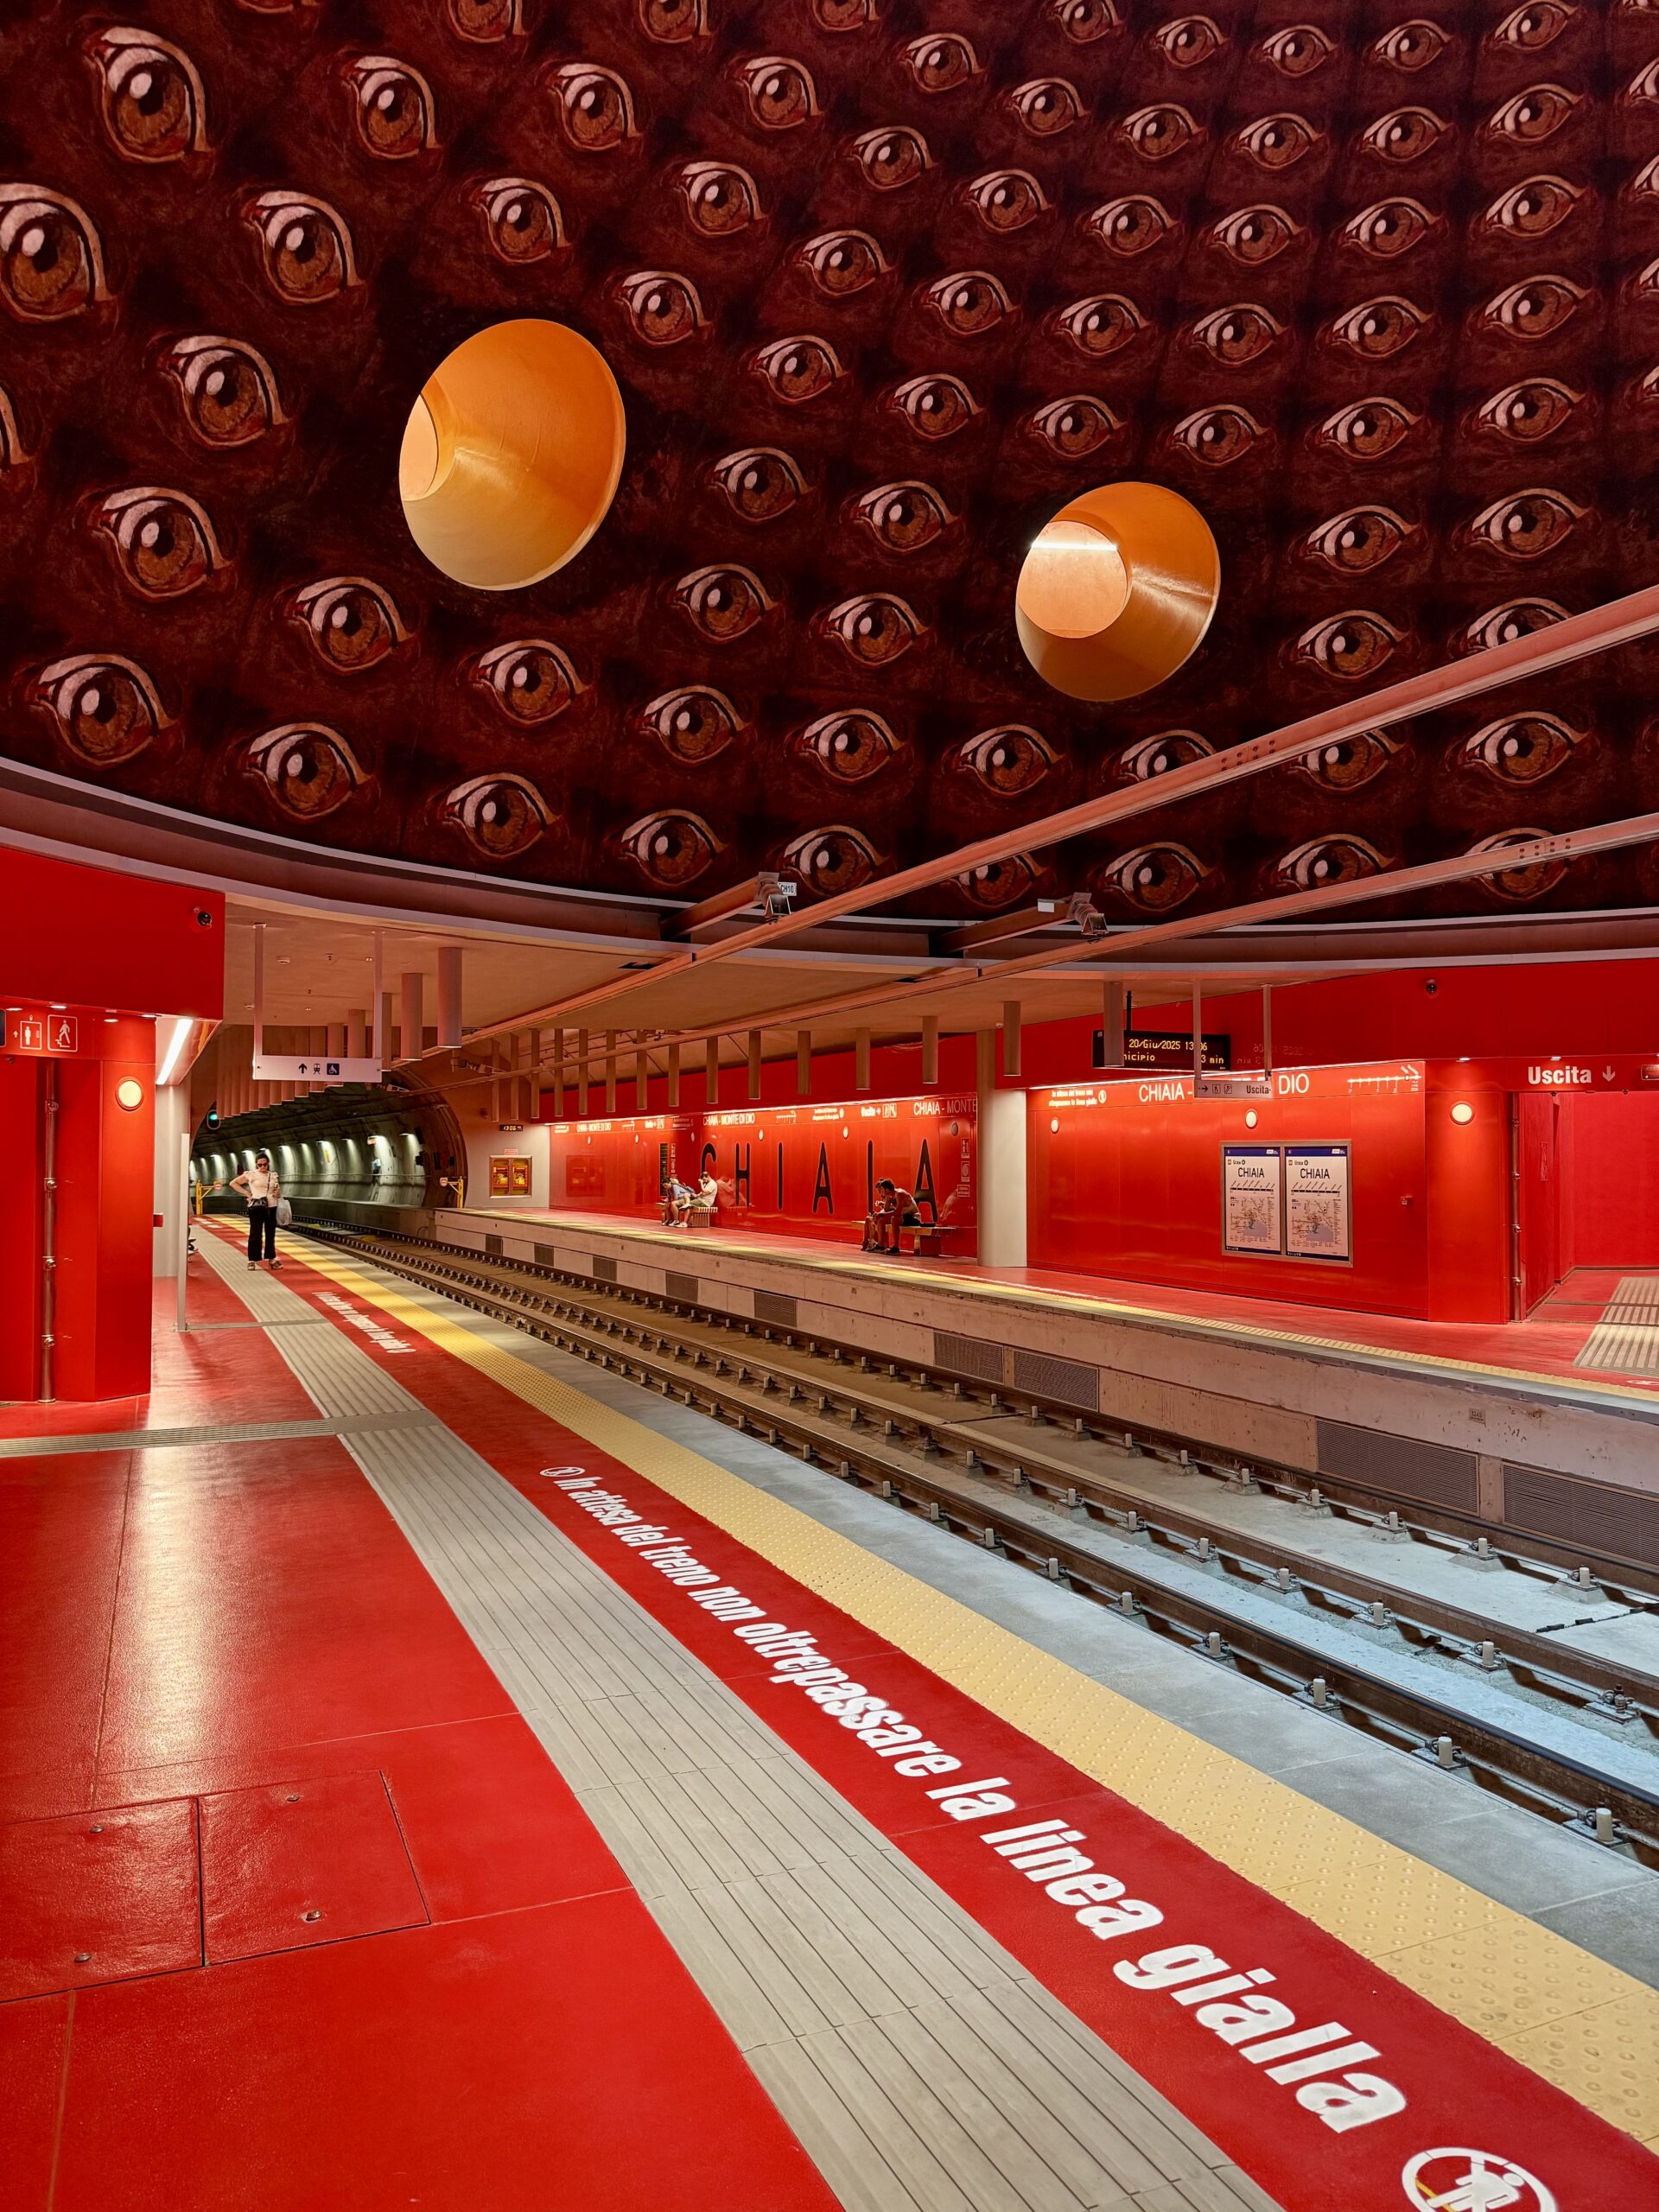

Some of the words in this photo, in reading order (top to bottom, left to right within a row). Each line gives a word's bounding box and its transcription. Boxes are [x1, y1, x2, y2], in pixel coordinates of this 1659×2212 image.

[1128, 1039, 1181, 1050] 20/Giu/2025
[1209, 1054, 1224, 1064] min
[1527, 1065, 1592, 1085] Uscita
[1138, 1082, 1185, 1103] CHIAIA
[1278, 1073, 1310, 1095] DIO
[1245, 1084, 1270, 1095] Uscita
[912, 1101, 941, 1116] CHIAIA
[1237, 1166, 1265, 1179] CHIAIA
[1300, 1168, 1331, 1179] CHIAIA
[553, 1476, 603, 1490] In
[567, 1490, 644, 1526] attesa
[611, 1524, 685, 1547] del
[639, 1545, 721, 1586] treno
[687, 1586, 767, 1622] non
[733, 1623, 963, 1777] oltrepassare
[925, 1777, 1017, 1821] la
[979, 1818, 1165, 1941] linea
[1112, 1944, 1408, 2133] gialla
